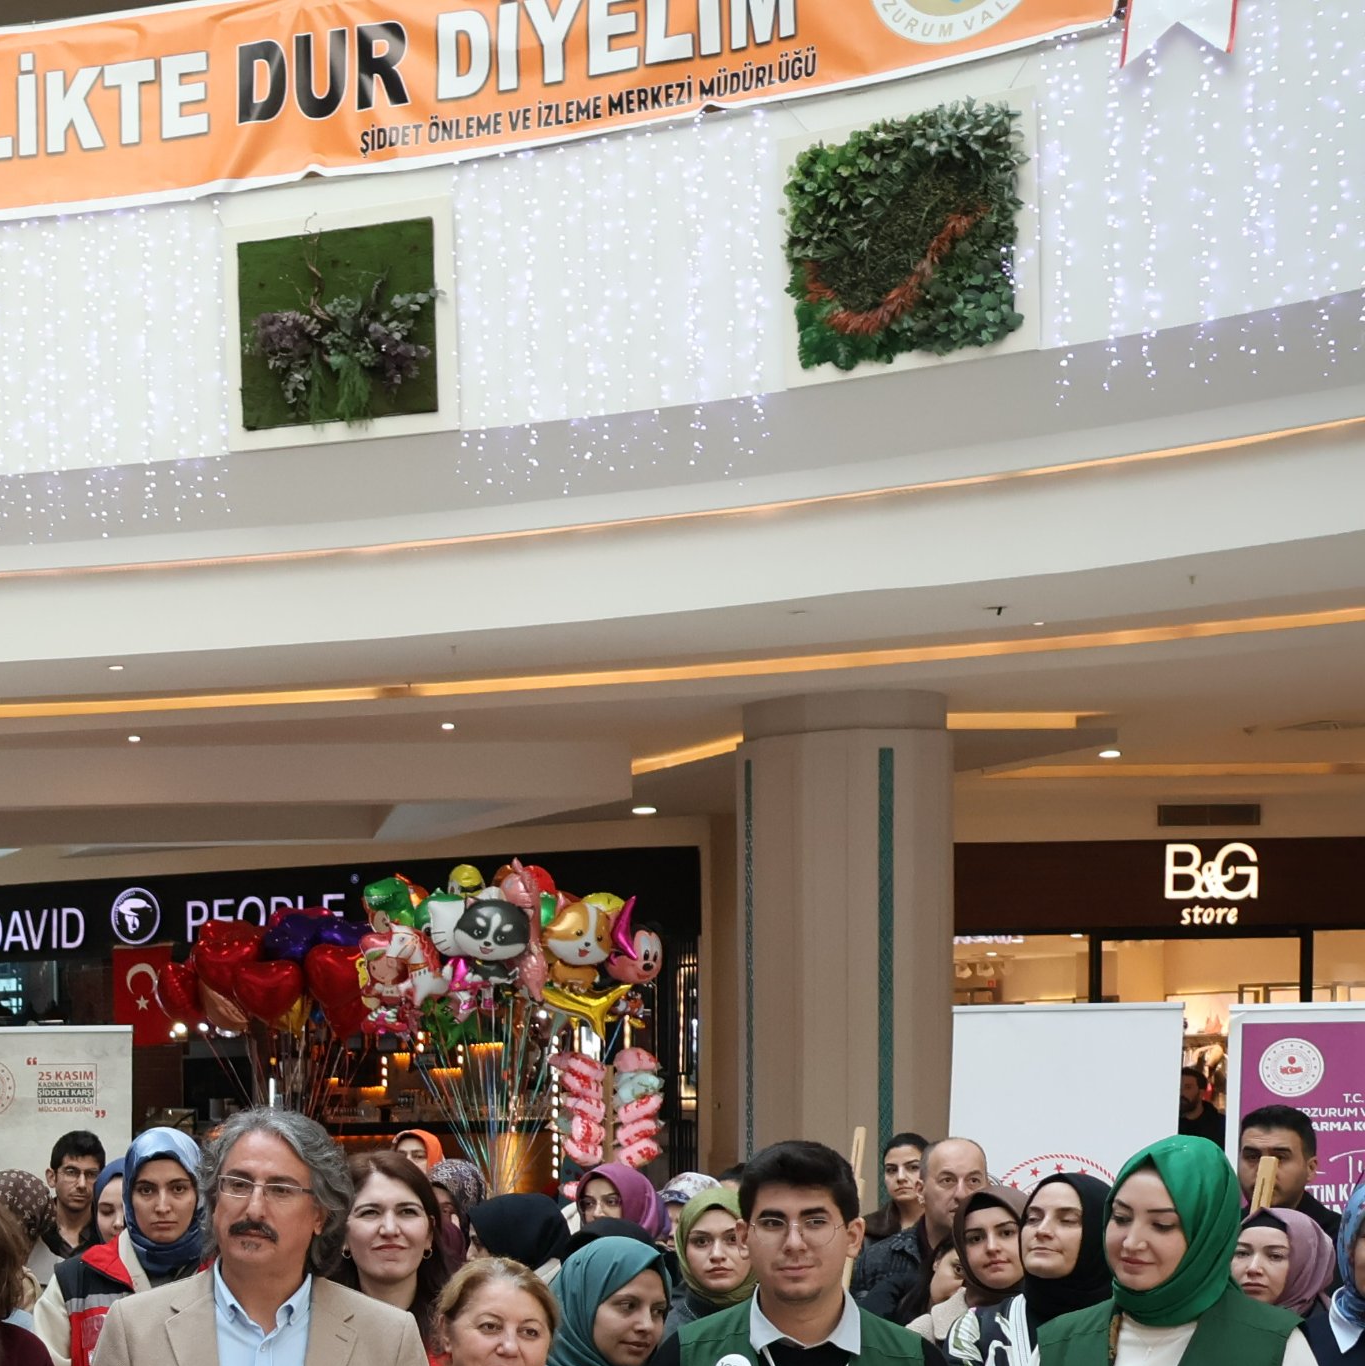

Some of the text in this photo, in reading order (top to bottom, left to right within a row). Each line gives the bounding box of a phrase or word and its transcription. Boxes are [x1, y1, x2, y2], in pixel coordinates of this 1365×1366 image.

[236, 20, 412, 127] DUR
[360, 46, 817, 158] ŞİDDET ÖNLEME VE İZLEME MERKEZİ MÜDÜRLÜĞÜ
[1164, 842, 1259, 900] B&G
[1180, 904, 1239, 925] store
[38, 1070, 94, 1081] 25 KASIM
[1295, 1107, 1358, 1118] RZURUM
